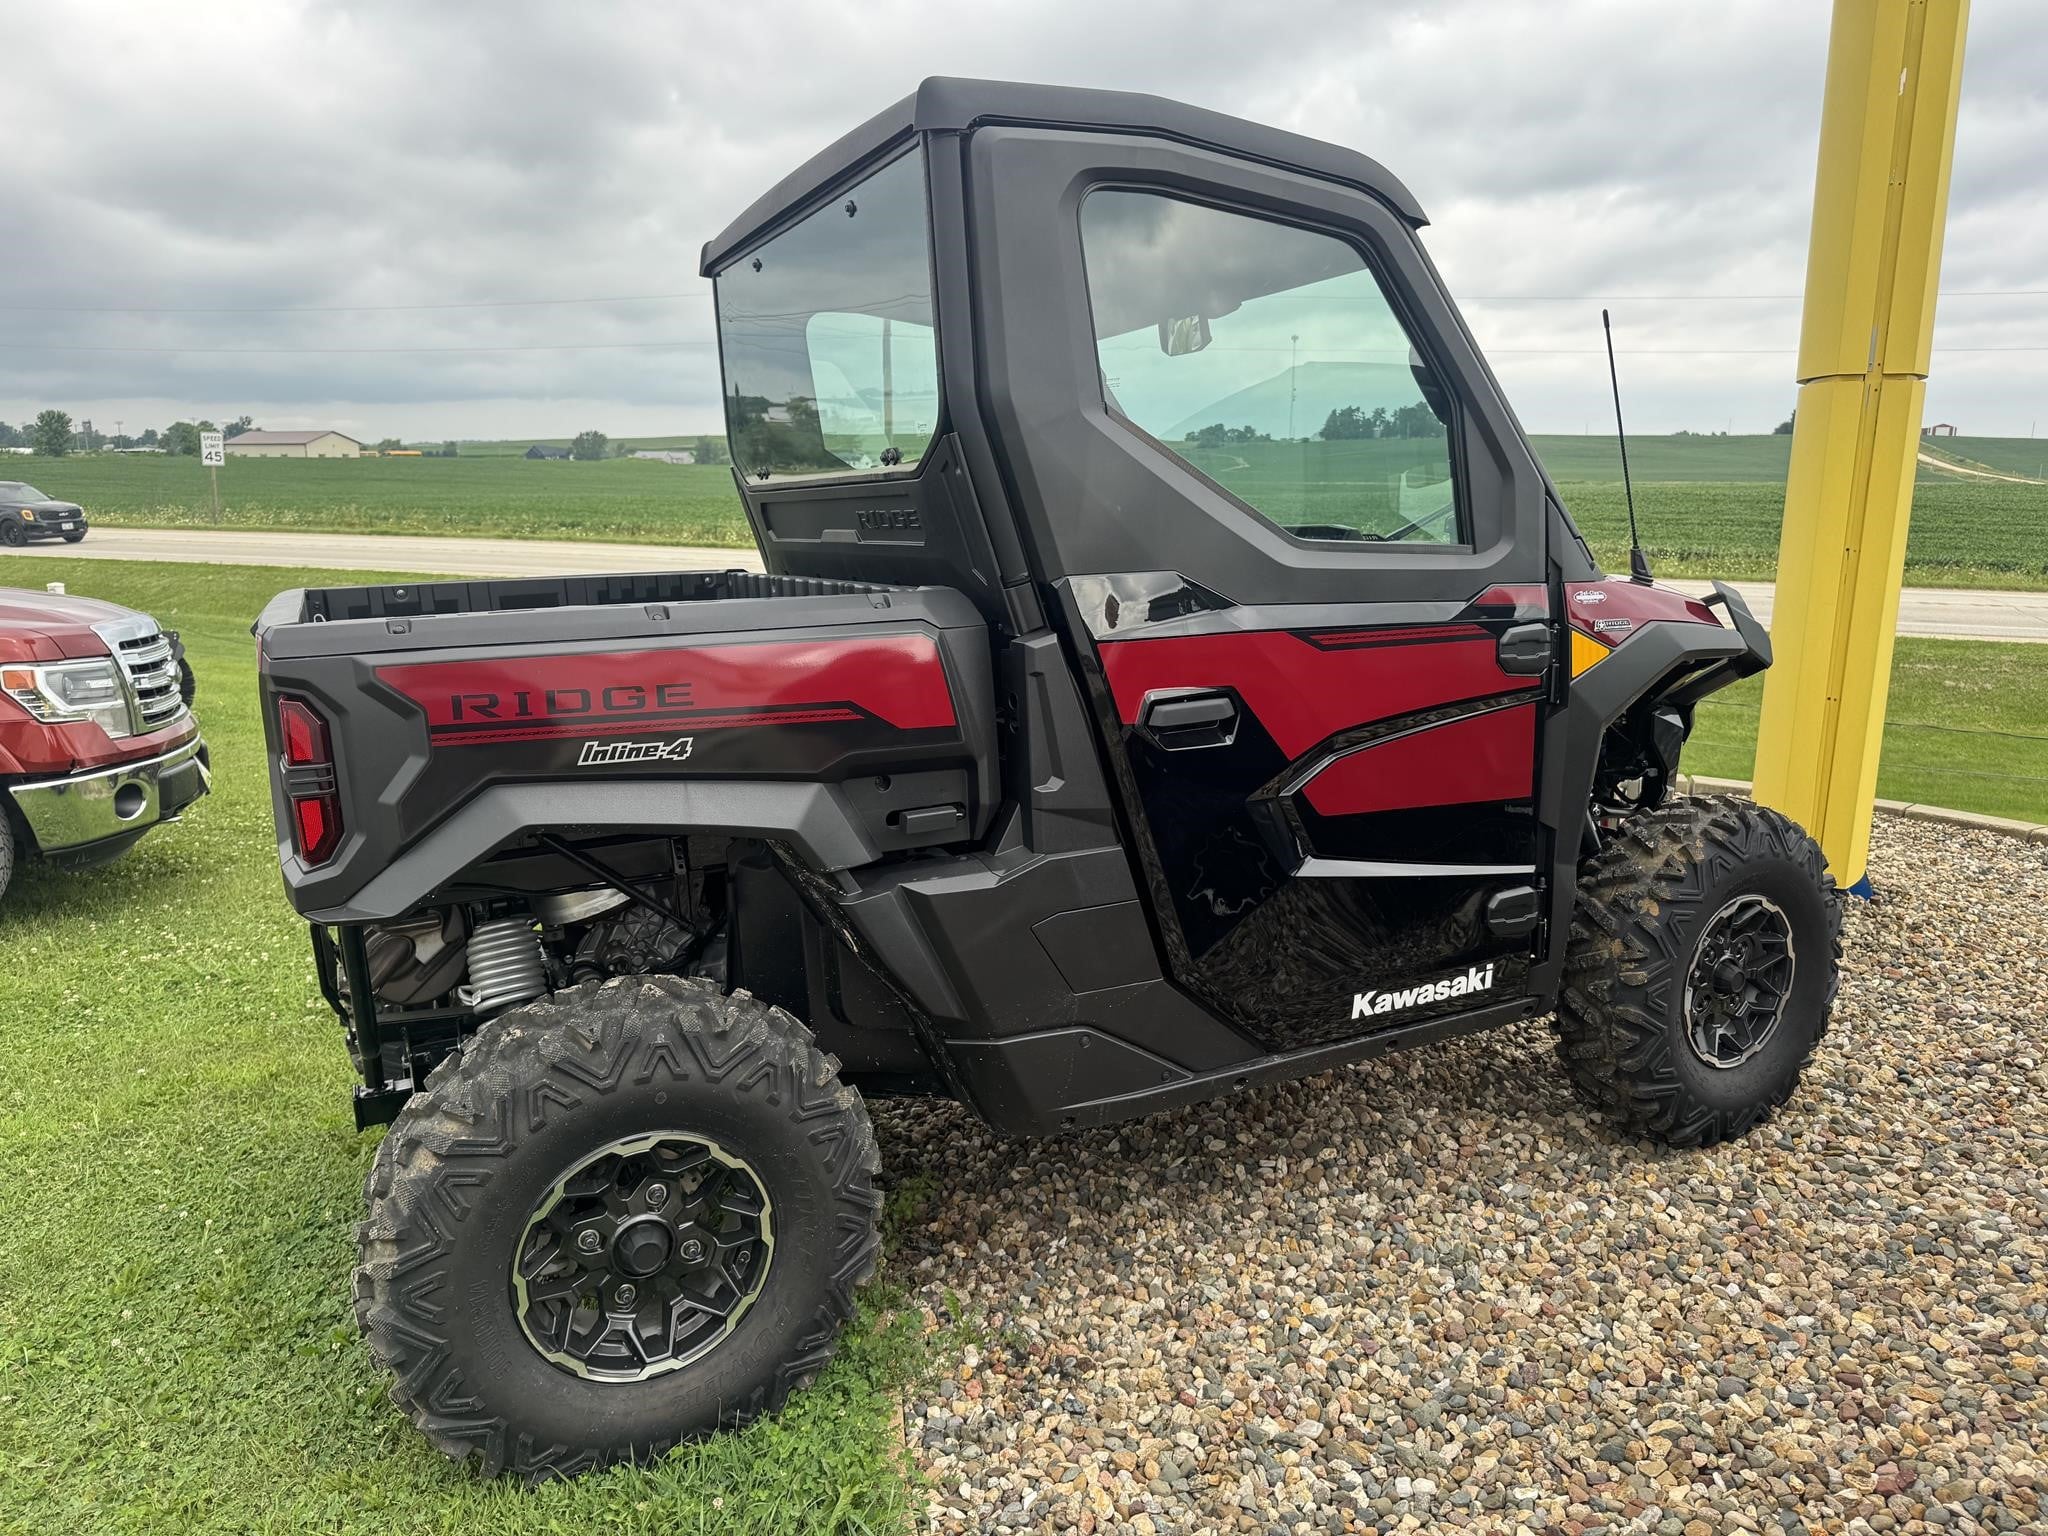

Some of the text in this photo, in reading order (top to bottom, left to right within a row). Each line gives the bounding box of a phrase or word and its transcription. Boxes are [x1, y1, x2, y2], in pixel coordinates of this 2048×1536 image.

[205, 451, 222, 462] 45
[856, 509, 921, 529] RIDGE
[451, 683, 695, 721] RIDGE
[577, 737, 694, 766] Inline-4
[1351, 963, 1494, 1020] Kawasaki
